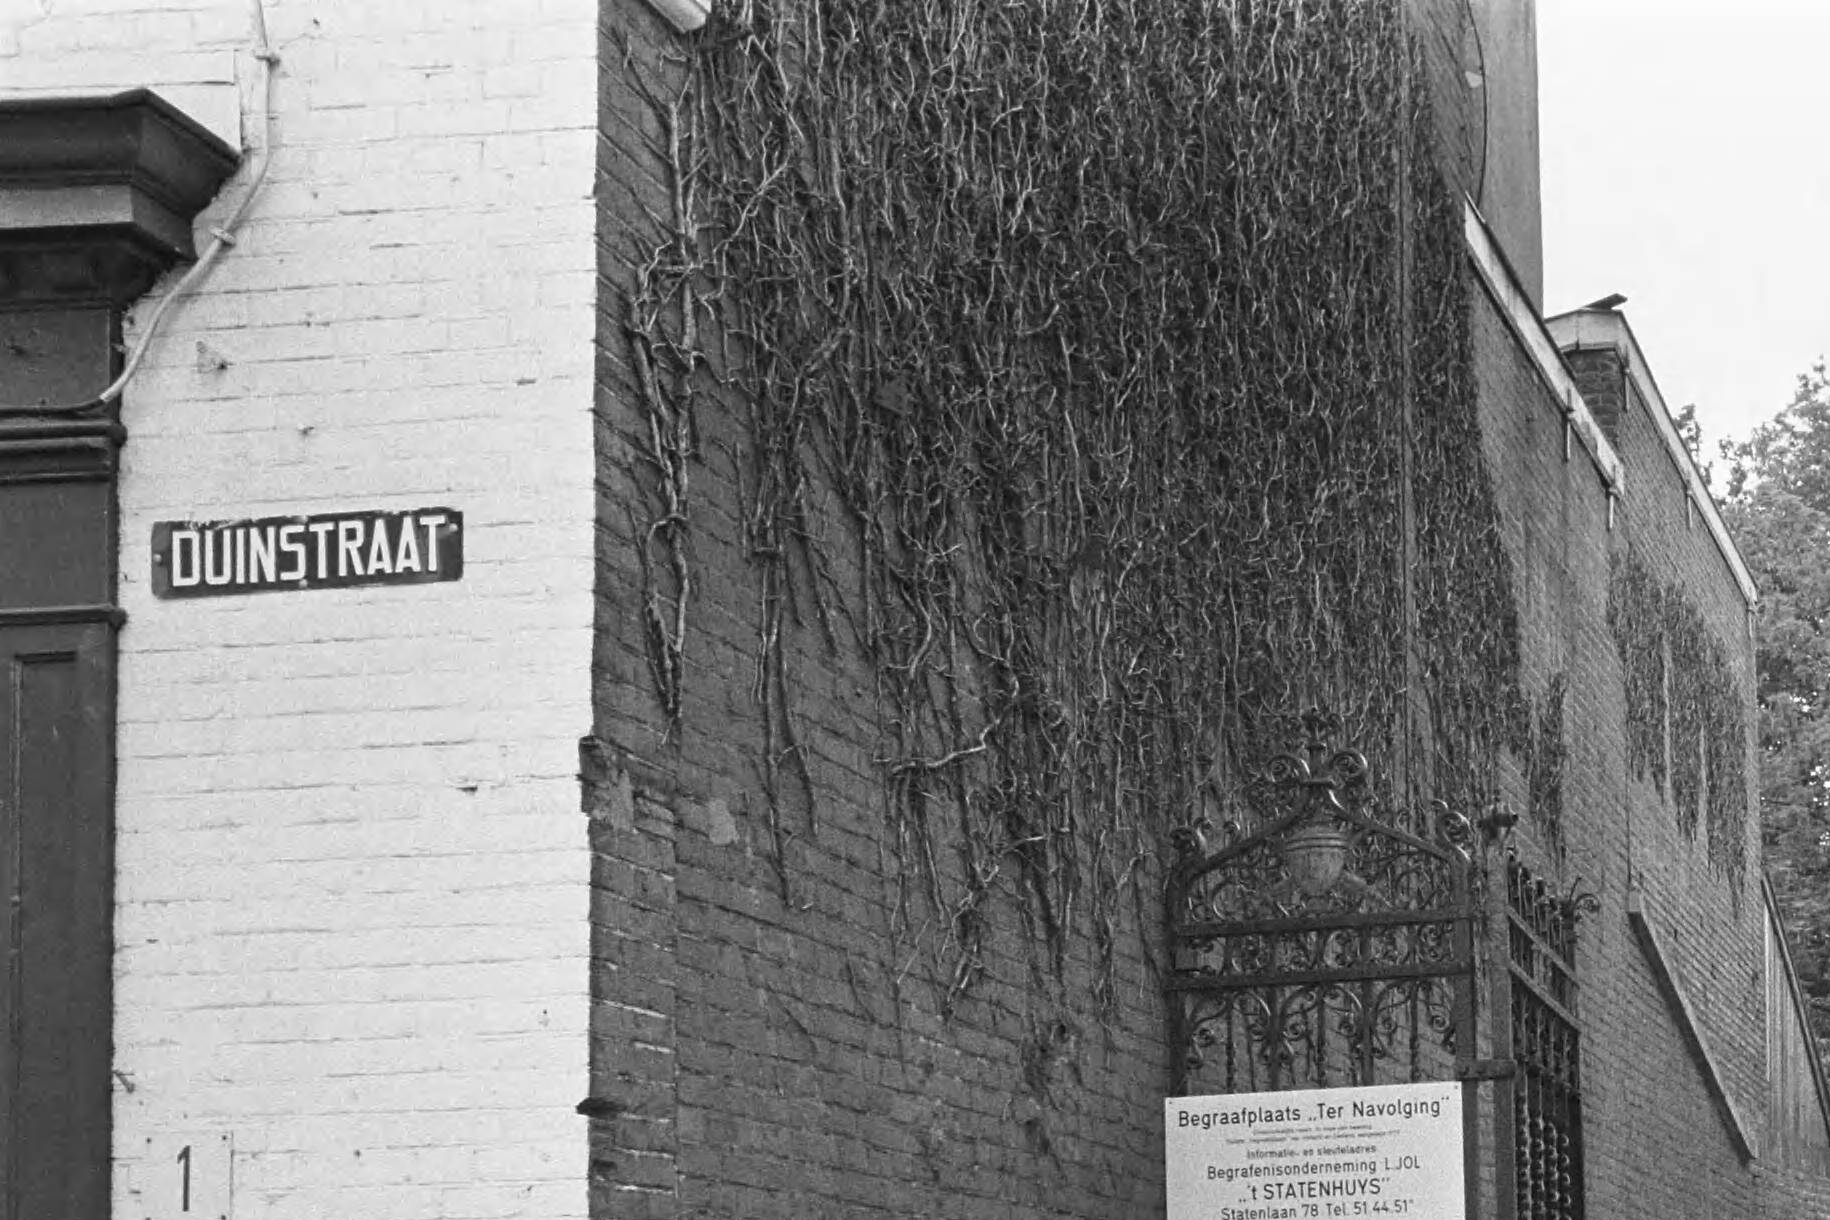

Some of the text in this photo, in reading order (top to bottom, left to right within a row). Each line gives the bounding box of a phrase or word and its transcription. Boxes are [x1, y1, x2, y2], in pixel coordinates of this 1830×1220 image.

[172, 515, 445, 587] DUINSTRAAT
[1178, 1105, 1301, 1130] Begraafplaats
[176, 1144, 191, 1212] 1
[1207, 1160, 1377, 1182] Begrafenisonderneming
[1221, 1206, 1297, 1220] Statenlaan
[1301, 1203, 1319, 1217] 78
